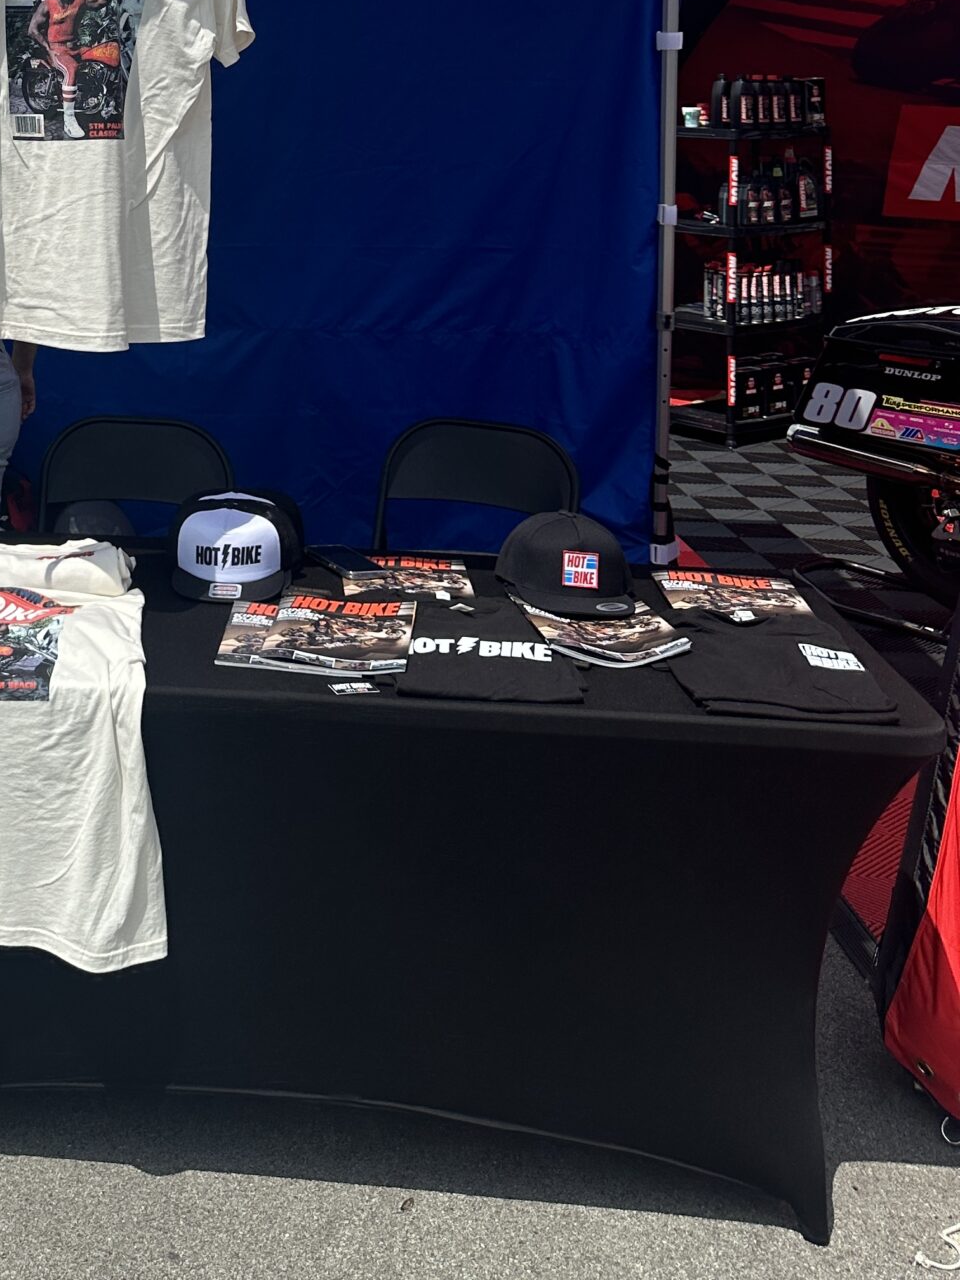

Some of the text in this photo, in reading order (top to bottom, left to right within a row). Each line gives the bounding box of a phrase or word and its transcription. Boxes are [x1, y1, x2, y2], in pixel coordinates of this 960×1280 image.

[884, 366, 942, 381] DUNLOP
[803, 382, 877, 430] 80
[195, 545, 262, 566] HOT BIKE
[400, 557, 453, 570] BIKE
[566, 554, 587, 569] HOT
[573, 571, 595, 585] BIKE
[667, 570, 718, 584] HOT
[717, 573, 773, 589] BIKE
[247, 602, 279, 617] HO
[292, 596, 402, 616] HOT BIKE
[409, 637, 553, 662] OT BIKE
